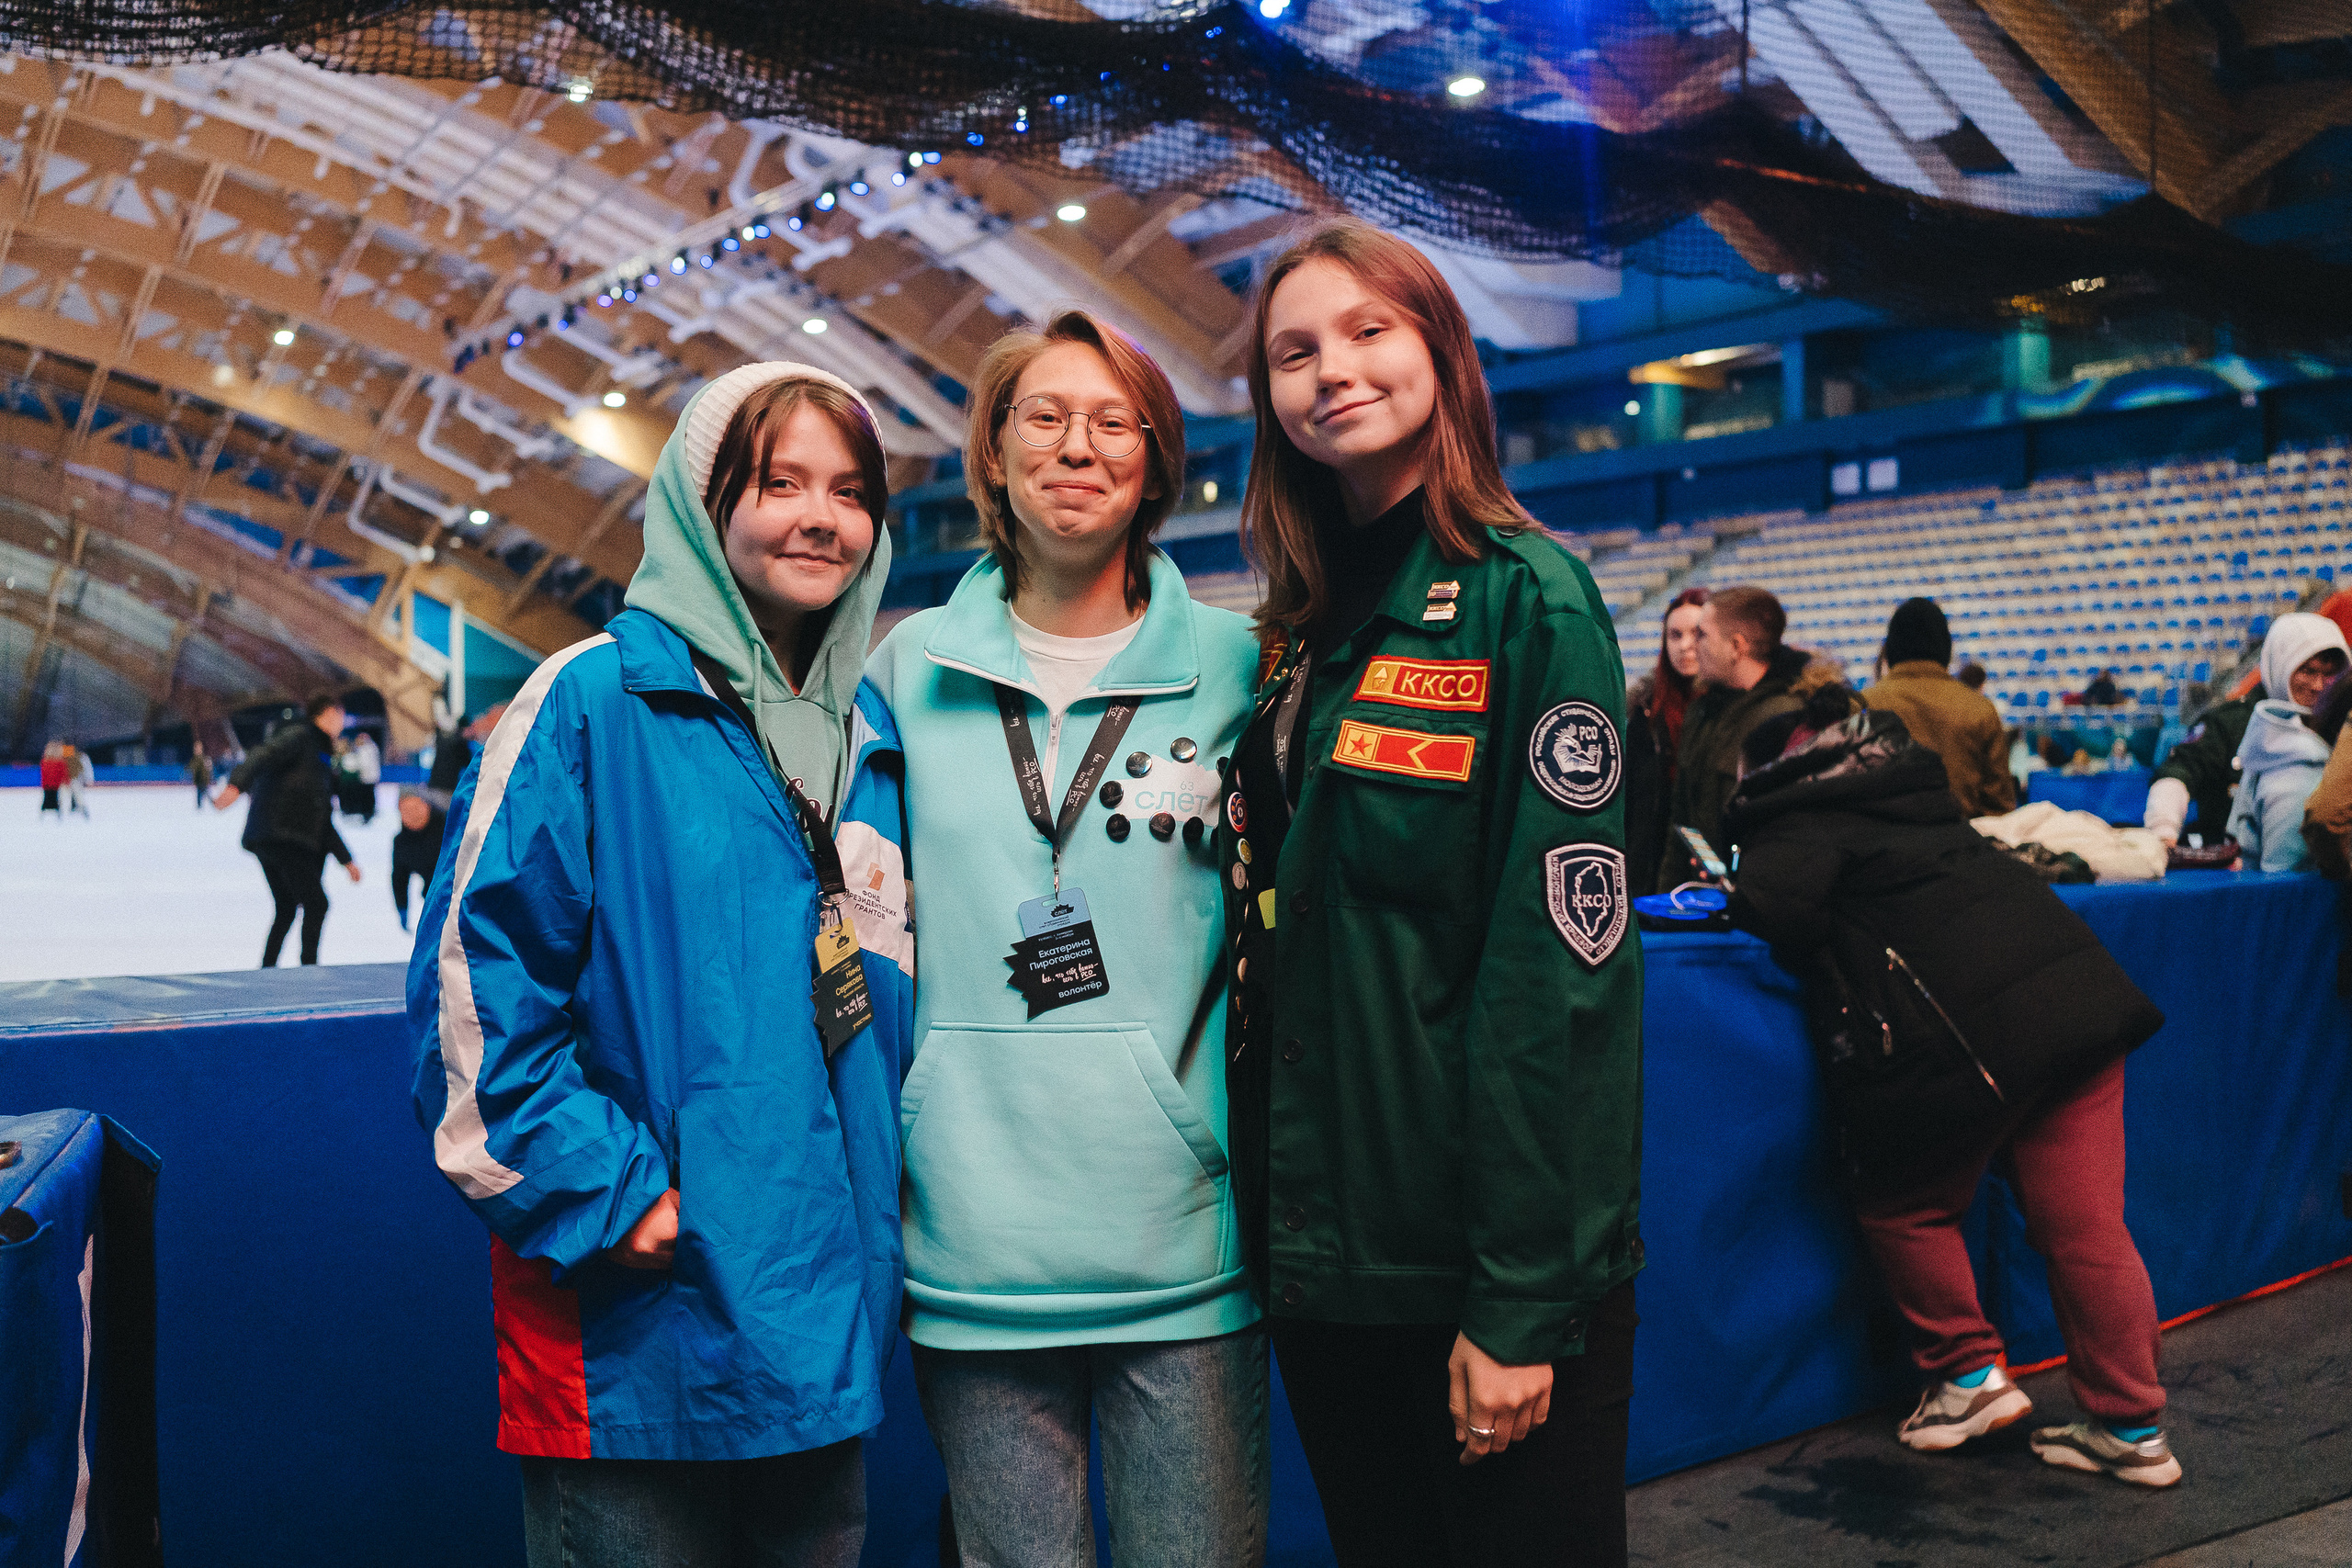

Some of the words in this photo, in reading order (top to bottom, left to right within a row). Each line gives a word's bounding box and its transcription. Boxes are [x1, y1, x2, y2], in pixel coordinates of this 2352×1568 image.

[1399, 671, 1477, 698] ККСО
[1578, 726, 1599, 740] РСО
[1180, 781, 1194, 791] 63
[846, 889, 898, 918] РЕЗИДЕНТСКИХ
[862, 889, 881, 903] ФОНД
[1571, 894, 1612, 908] ККСО
[854, 903, 886, 919] ГРАНТОВ
[1038, 939, 1091, 958] Екатерина
[1029, 948, 1093, 970] Пироговская
[845, 964, 862, 978] Нина
[835, 974, 864, 996] Серякова
[1057, 980, 1102, 998] волонтёр
